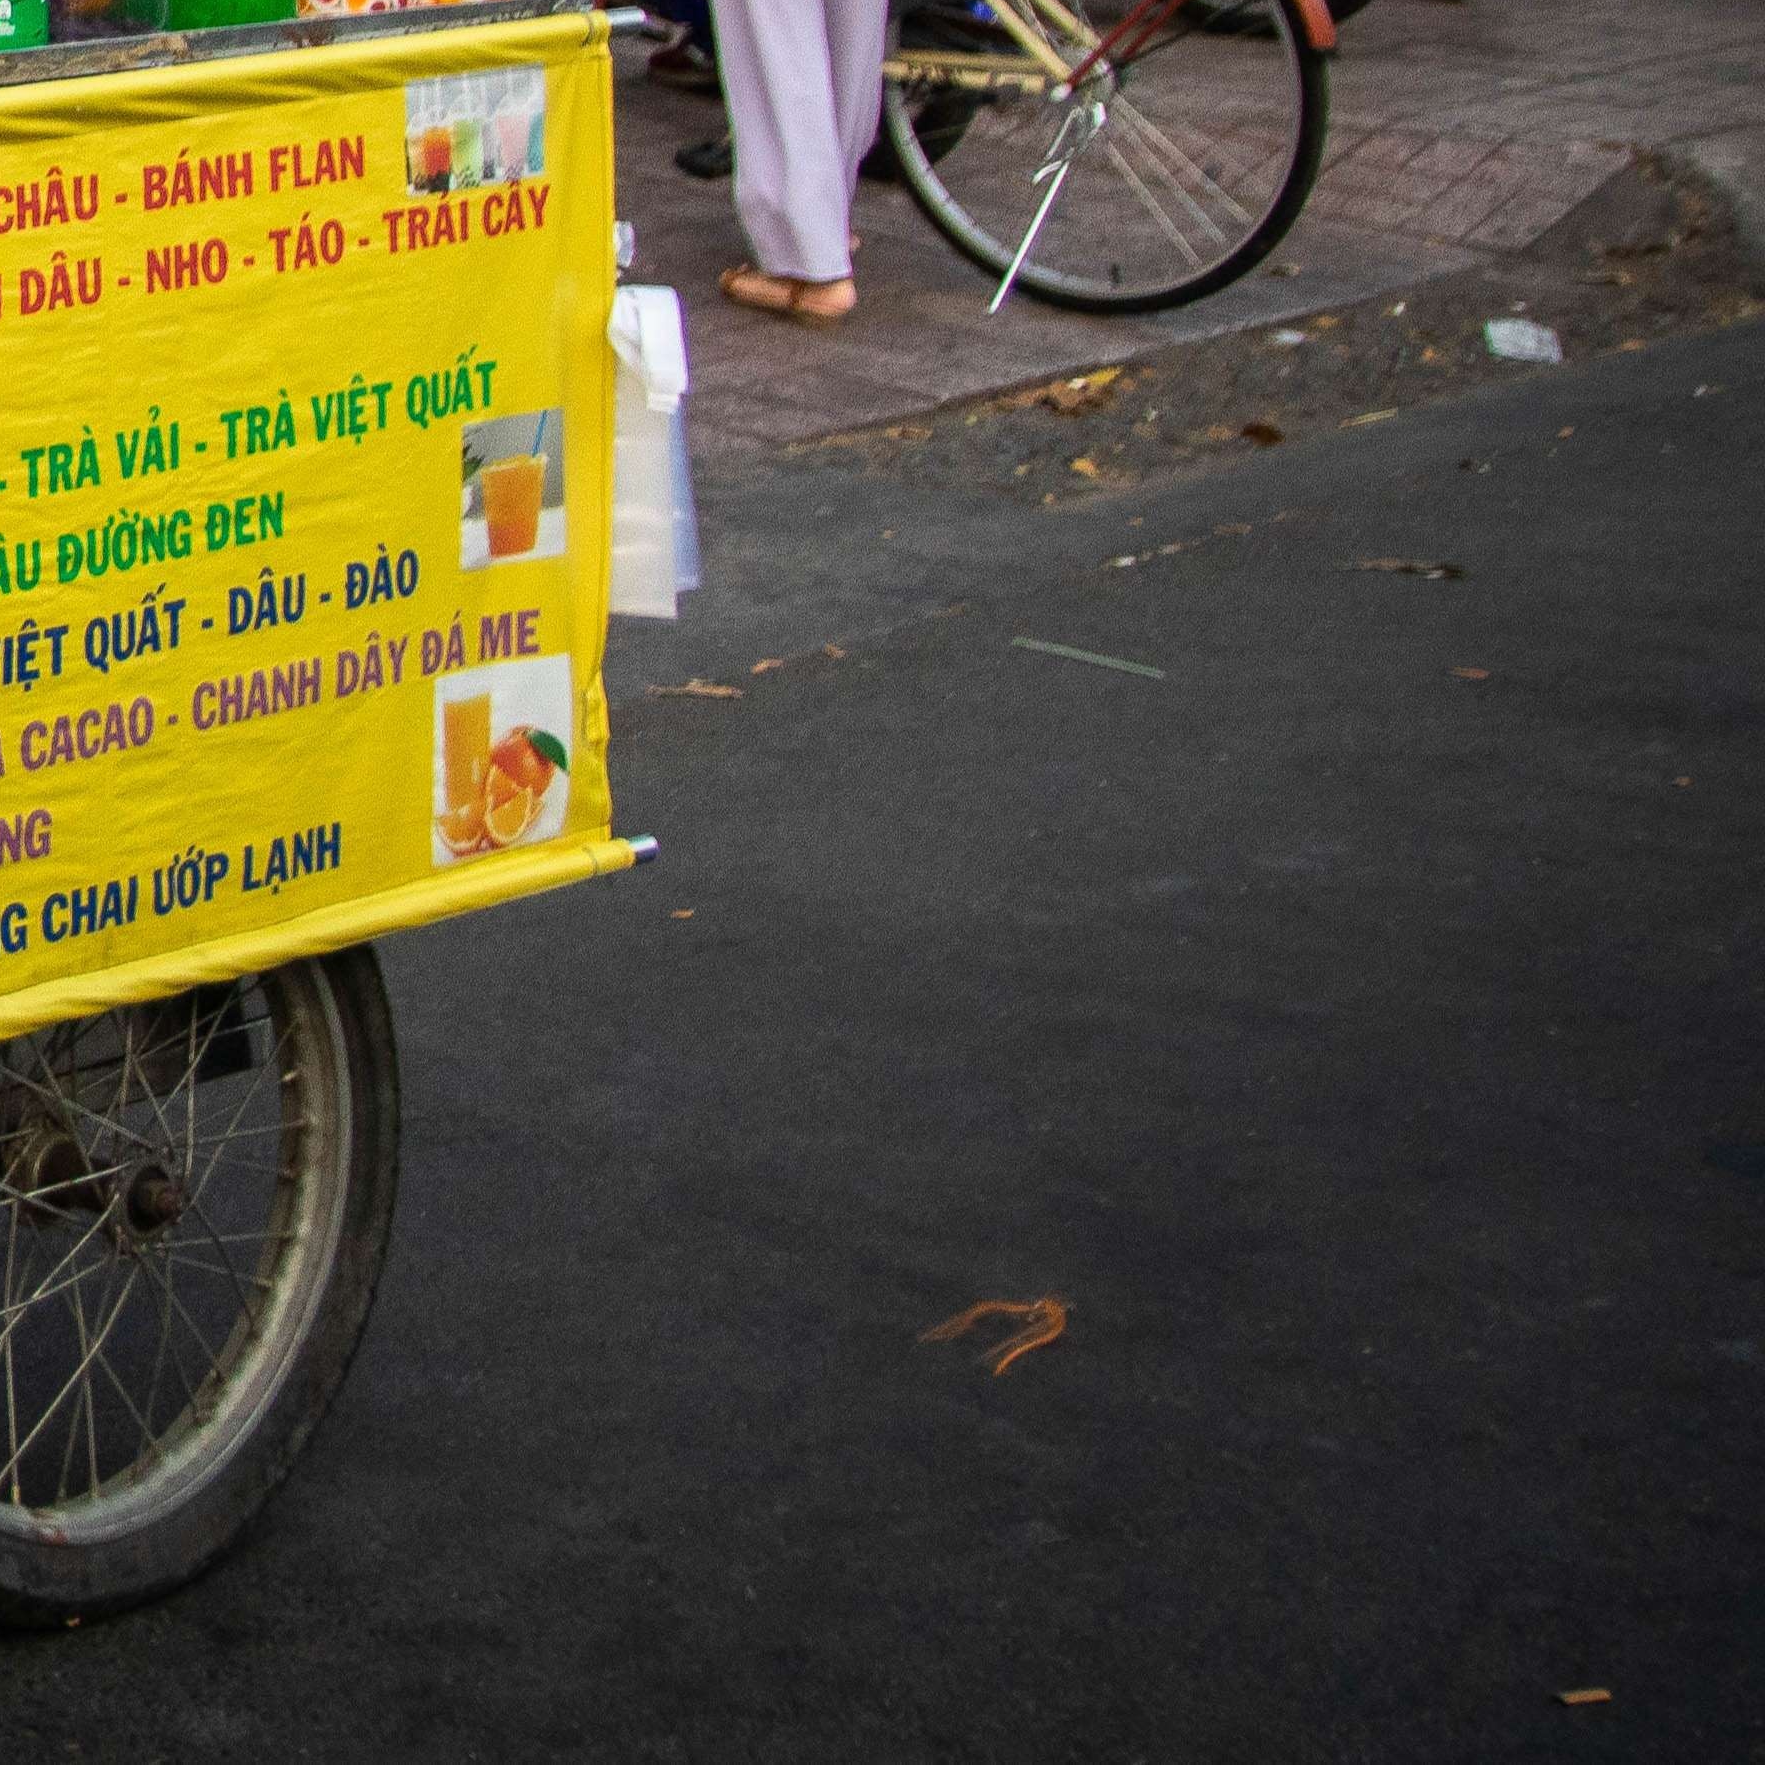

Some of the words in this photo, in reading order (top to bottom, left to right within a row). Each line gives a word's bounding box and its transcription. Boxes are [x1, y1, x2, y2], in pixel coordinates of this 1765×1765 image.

[143, 148, 253, 211] BÁNH
[268, 134, 365, 193] FLAN
[19, 251, 102, 315] DÂU
[146, 238, 228, 294] NHO
[268, 212, 345, 273] TÁO
[382, 189, 471, 254] TRÁI
[481, 178, 550, 238] CÂY
[20, 425, 101, 498] TRÀ
[116, 406, 180, 479] VẢI
[220, 389, 296, 459] TRÀ
[311, 374, 393, 444] VIỆT
[406, 346, 501, 430] QUẤT
[57, 508, 192, 584] ĐƯỜNG
[204, 491, 284, 552] ĐEN
[84, 583, 186, 674] QUẤT
[228, 566, 306, 636] DÂU
[344, 543, 419, 610] ĐÀO
[20, 697, 154, 771] CACAO
[192, 658, 321, 731] CHANH
[336, 631, 408, 698] DÂY
[420, 610, 466, 677] ĐÁ
[476, 608, 541, 664] ME
[41, 875, 139, 943] CHAI
[152, 845, 230, 916] ƯỚP
[241, 822, 341, 895] LẠNH
